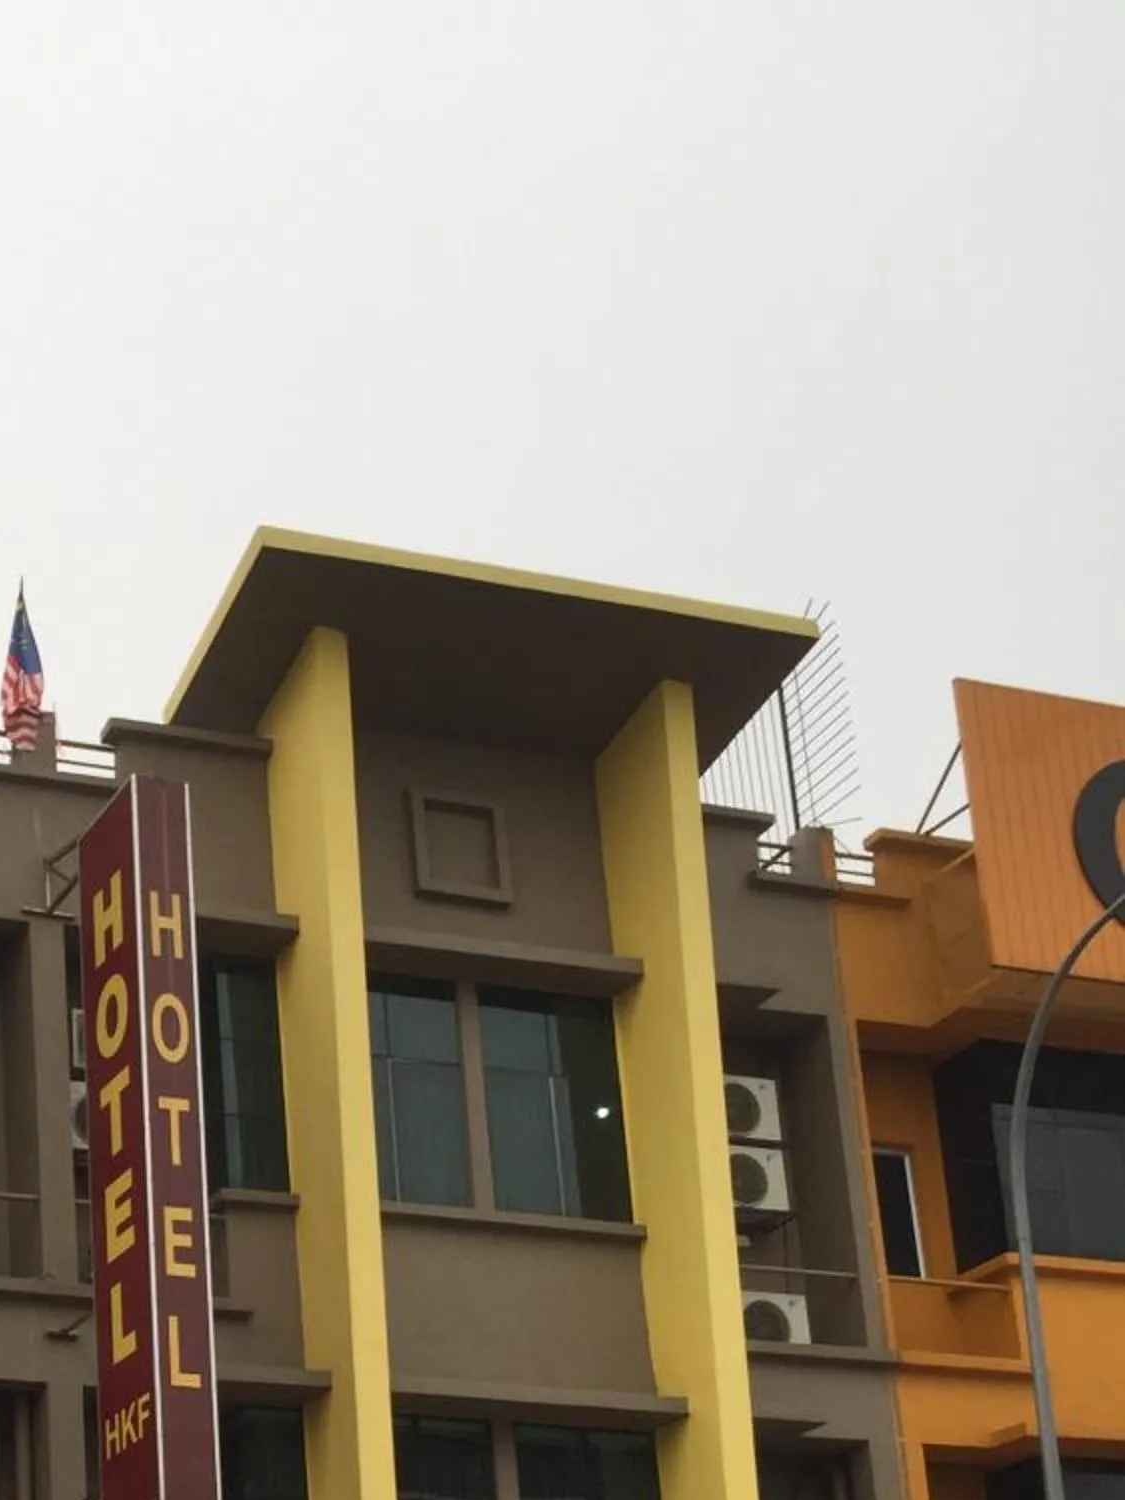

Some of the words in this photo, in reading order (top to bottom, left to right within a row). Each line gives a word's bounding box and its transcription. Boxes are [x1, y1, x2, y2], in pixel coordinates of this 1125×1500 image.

[93, 868, 138, 1366] HOTEL
[150, 890, 202, 1389] HOTEL
[105, 1392, 152, 1461] HKF
